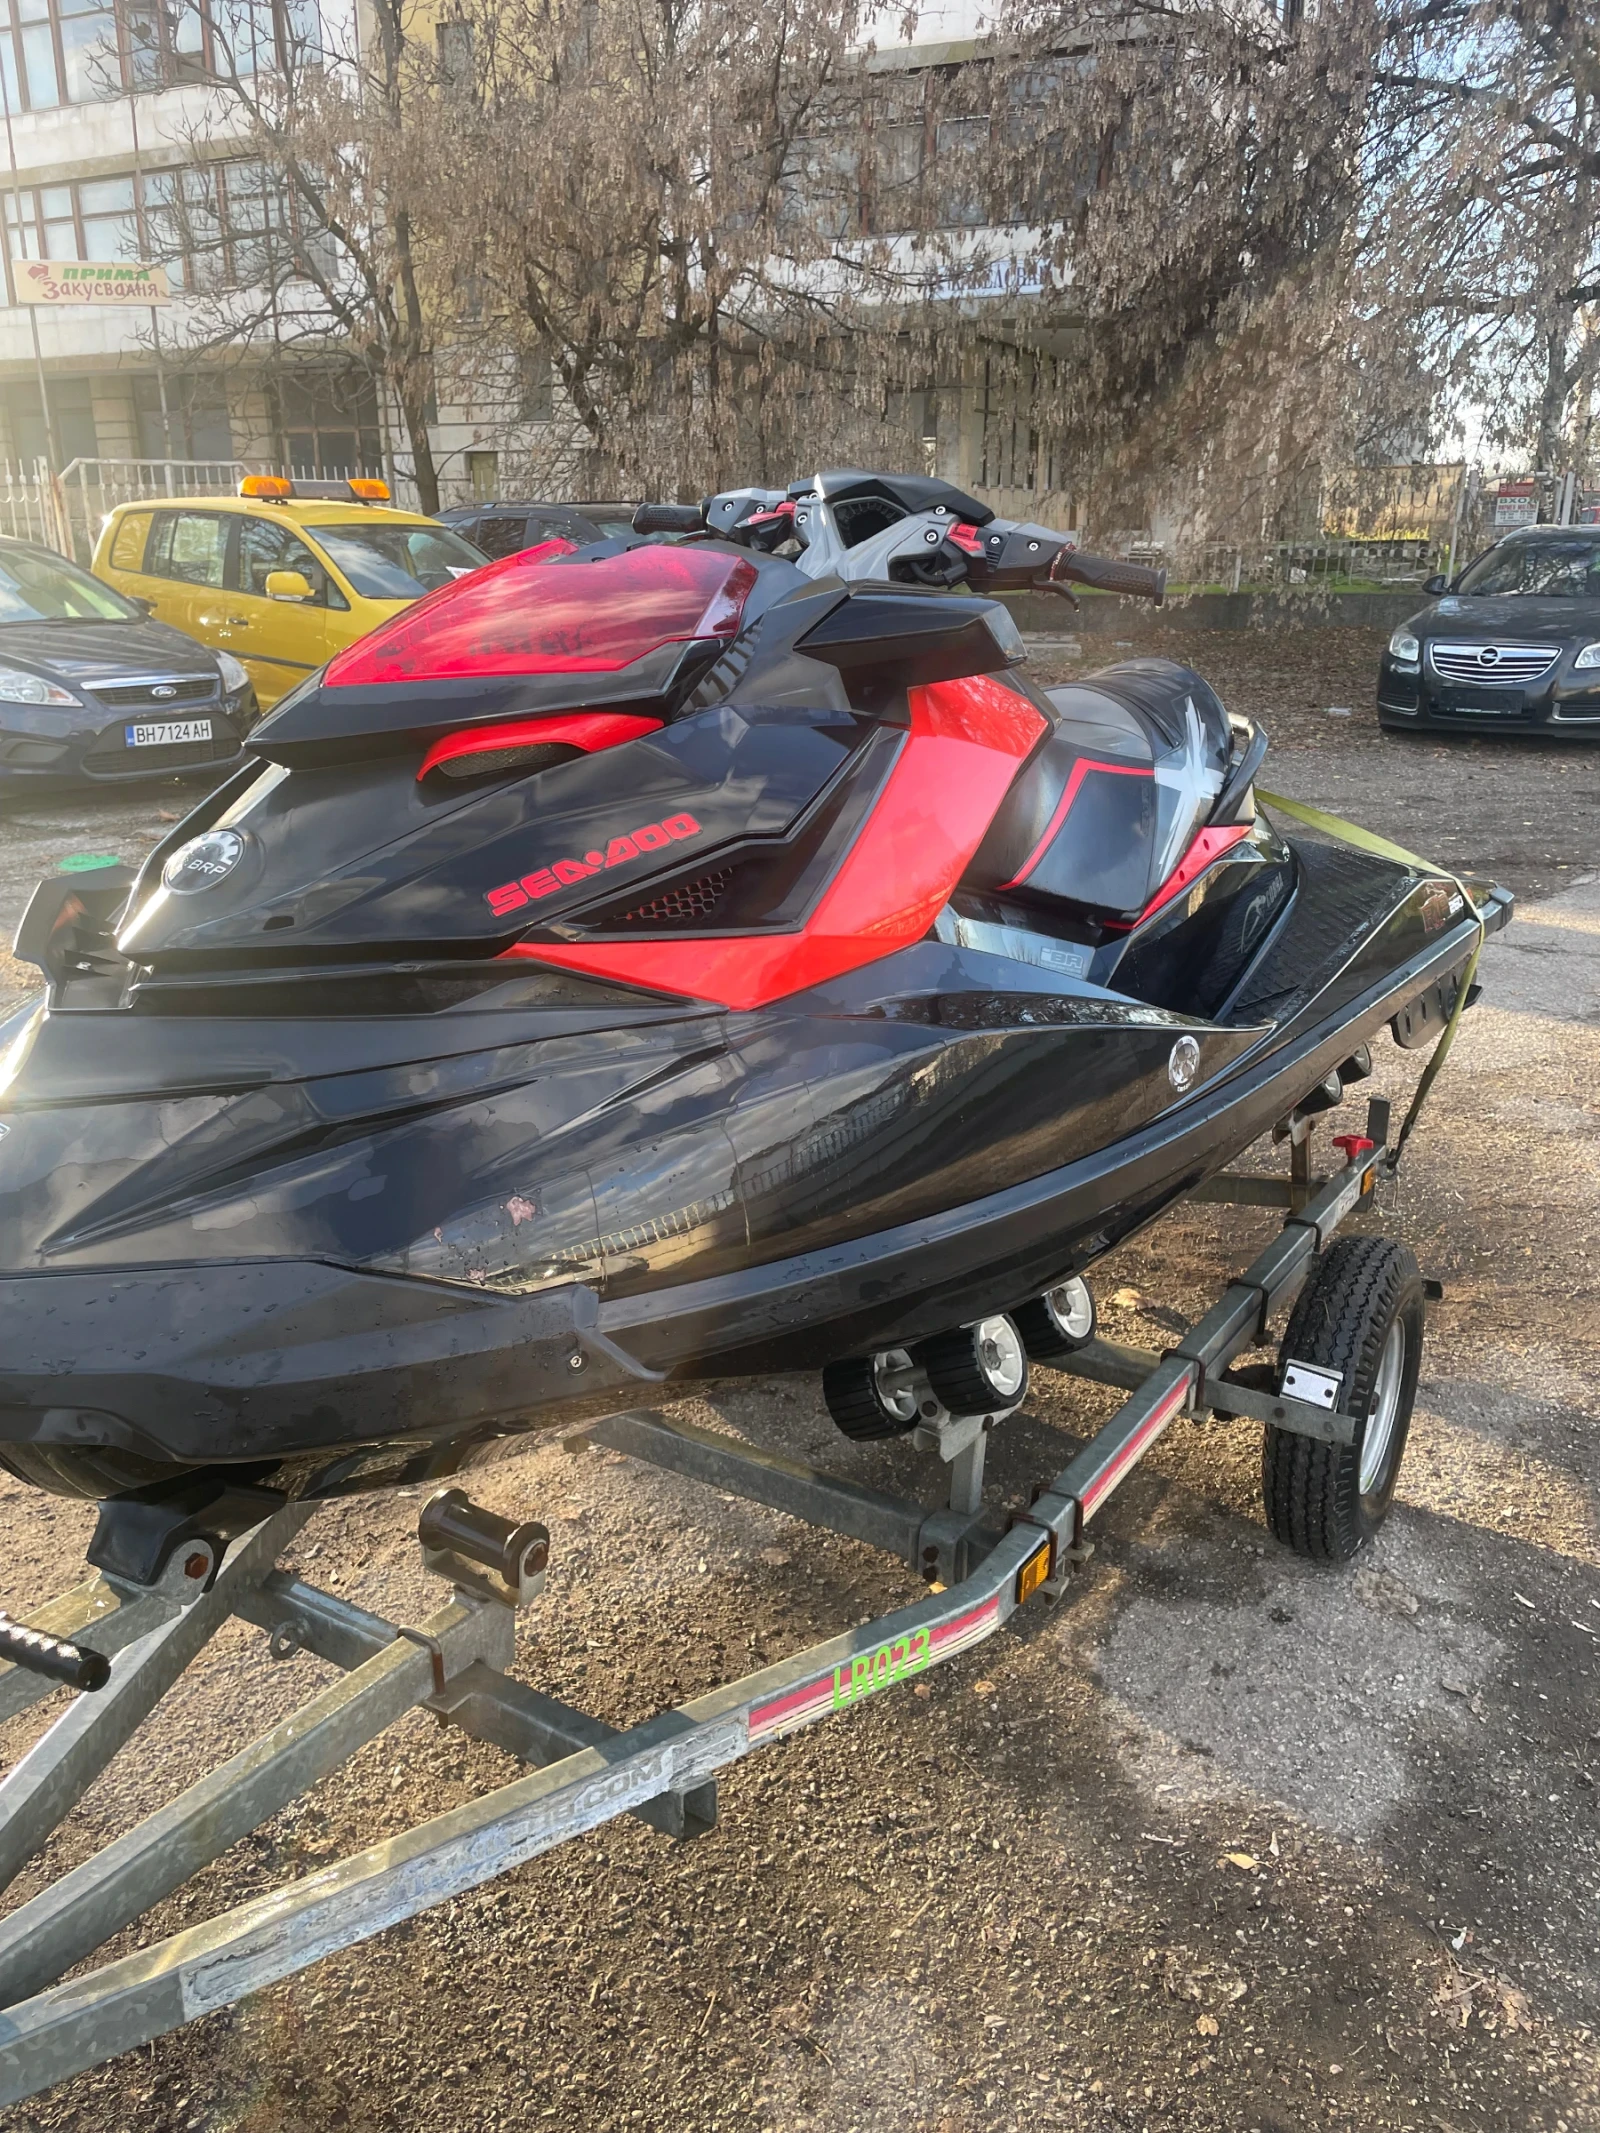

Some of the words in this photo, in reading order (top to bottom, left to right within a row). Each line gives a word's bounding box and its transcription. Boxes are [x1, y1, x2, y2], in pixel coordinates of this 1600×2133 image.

[62, 267, 150, 281] ПРИМА
[187, 859, 227, 875] BRP
[832, 1627, 931, 1711] LR023
